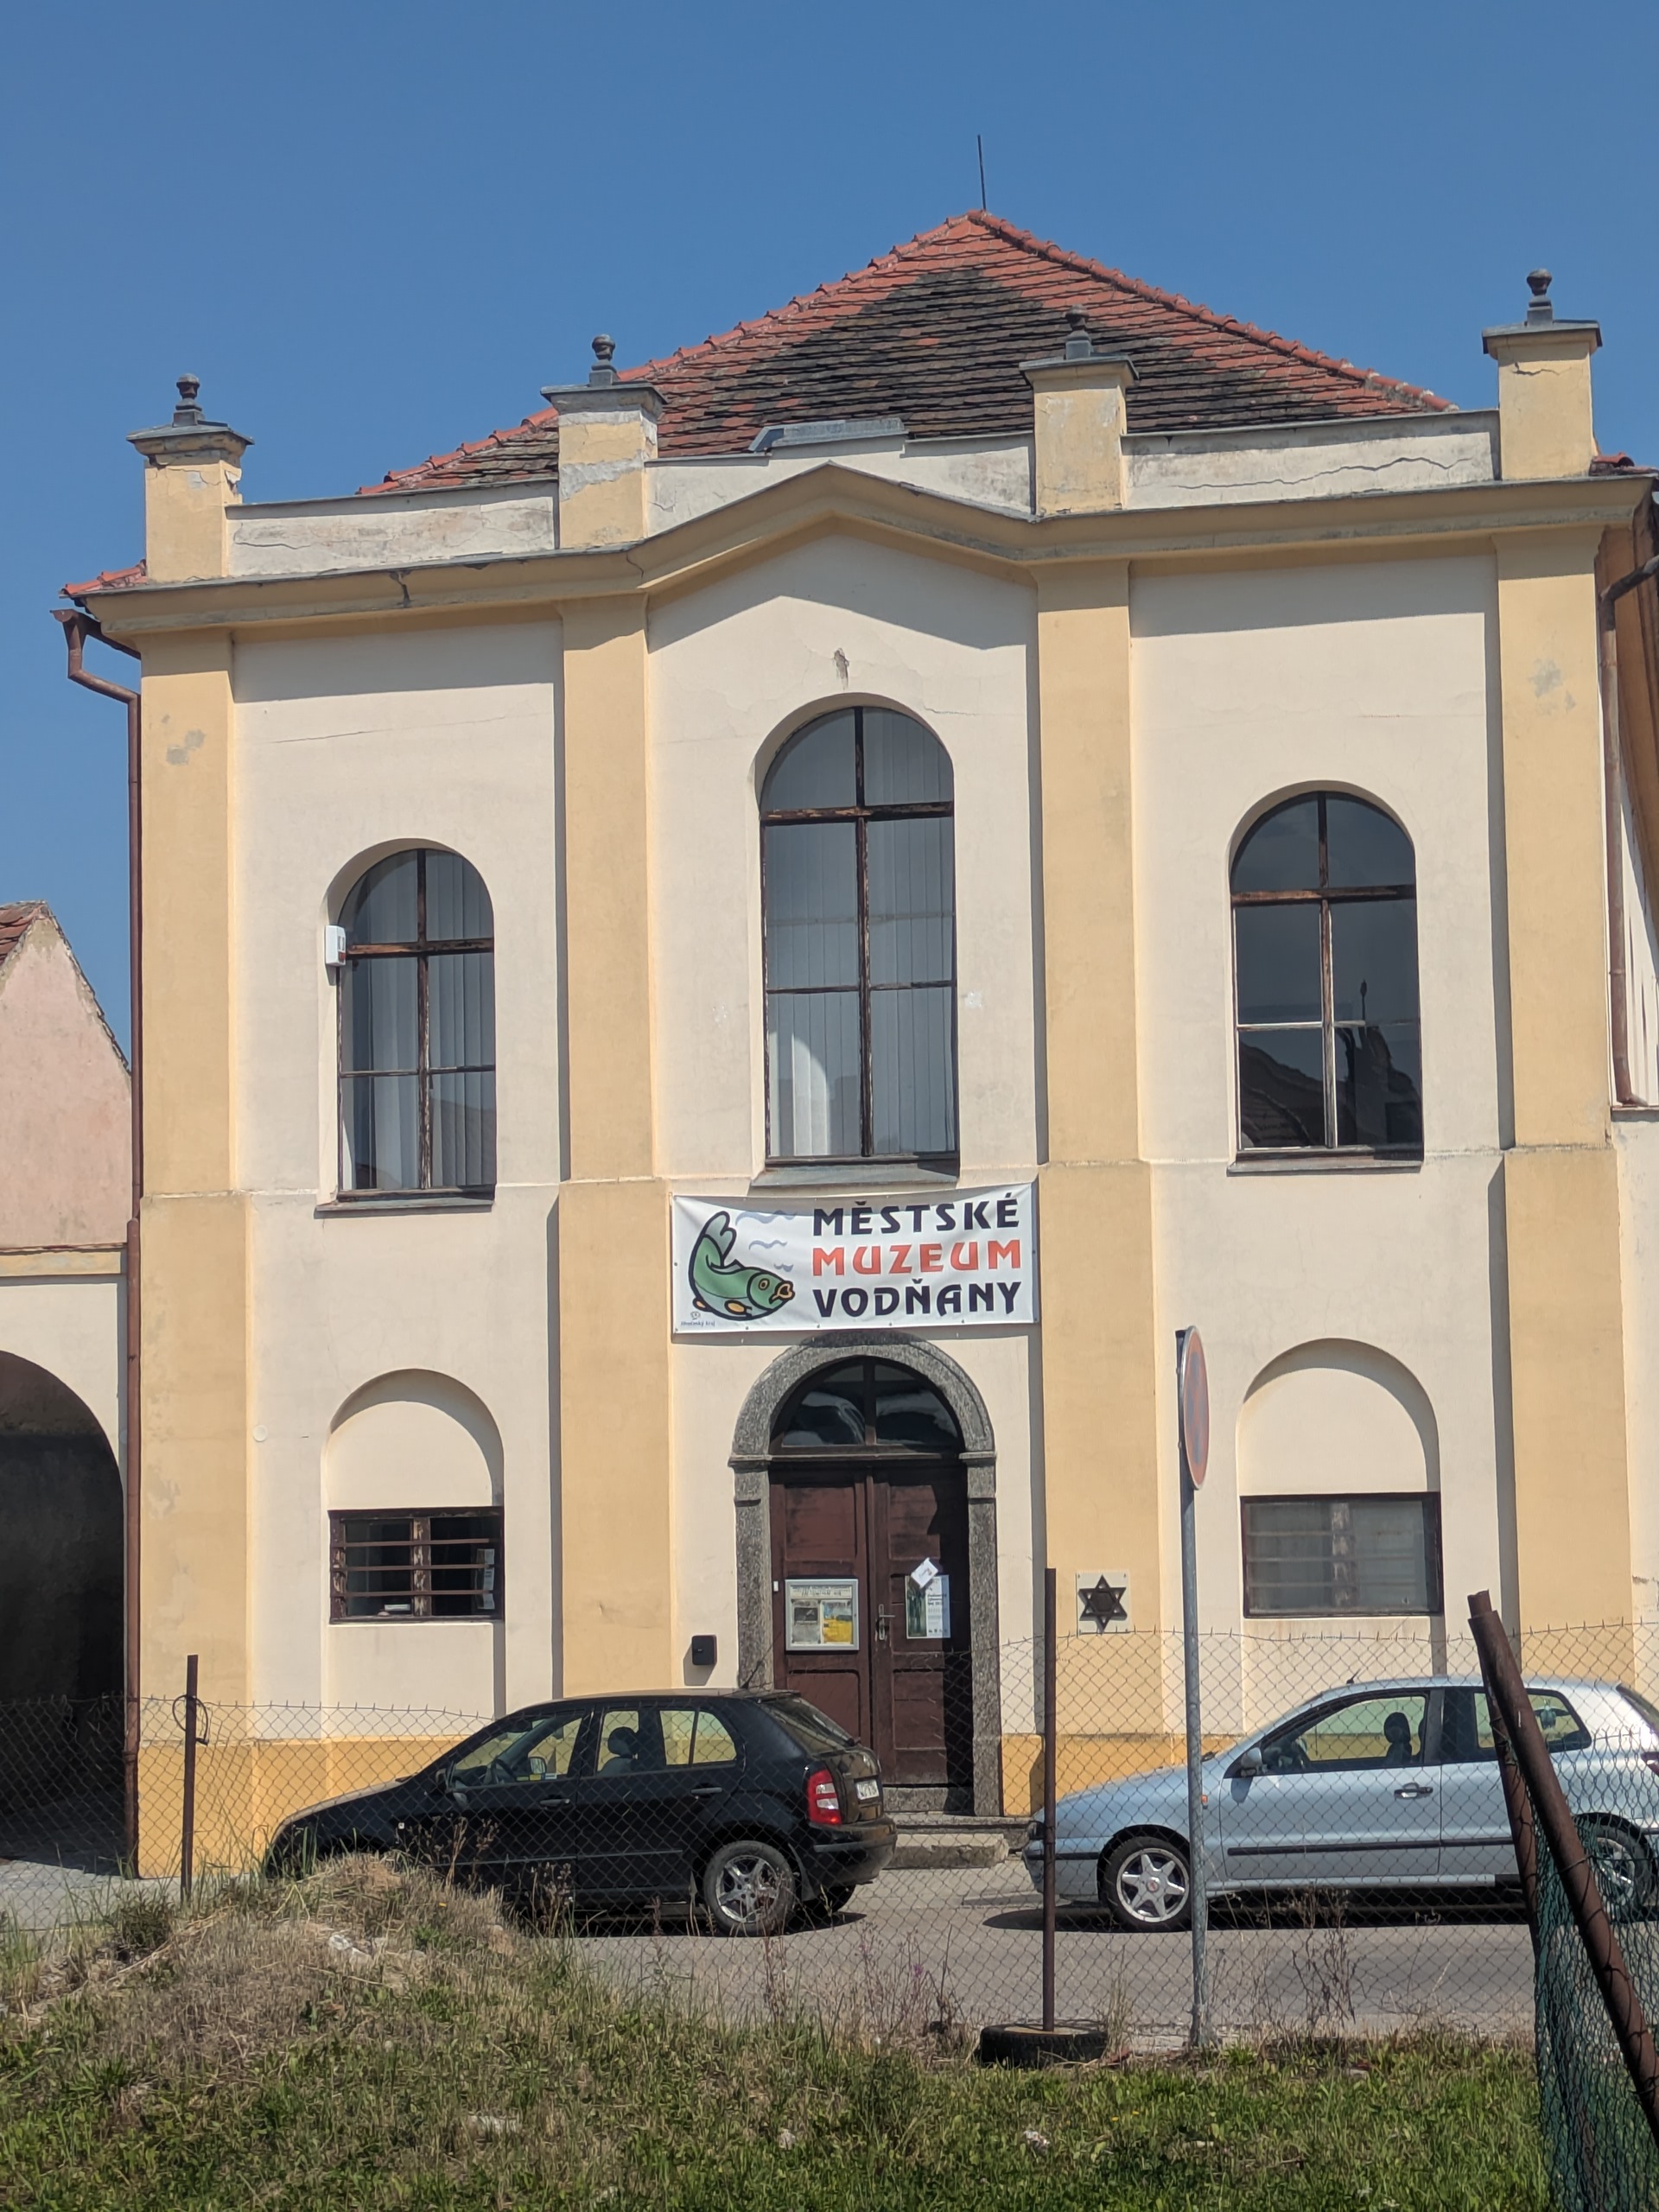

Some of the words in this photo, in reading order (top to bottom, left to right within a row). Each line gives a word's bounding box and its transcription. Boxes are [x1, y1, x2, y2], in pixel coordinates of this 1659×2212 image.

[812, 1192, 1020, 1236] MĚSTSKÉ
[812, 1240, 1020, 1276] MUZEUM
[812, 1278, 1021, 1318] VODŇANY
